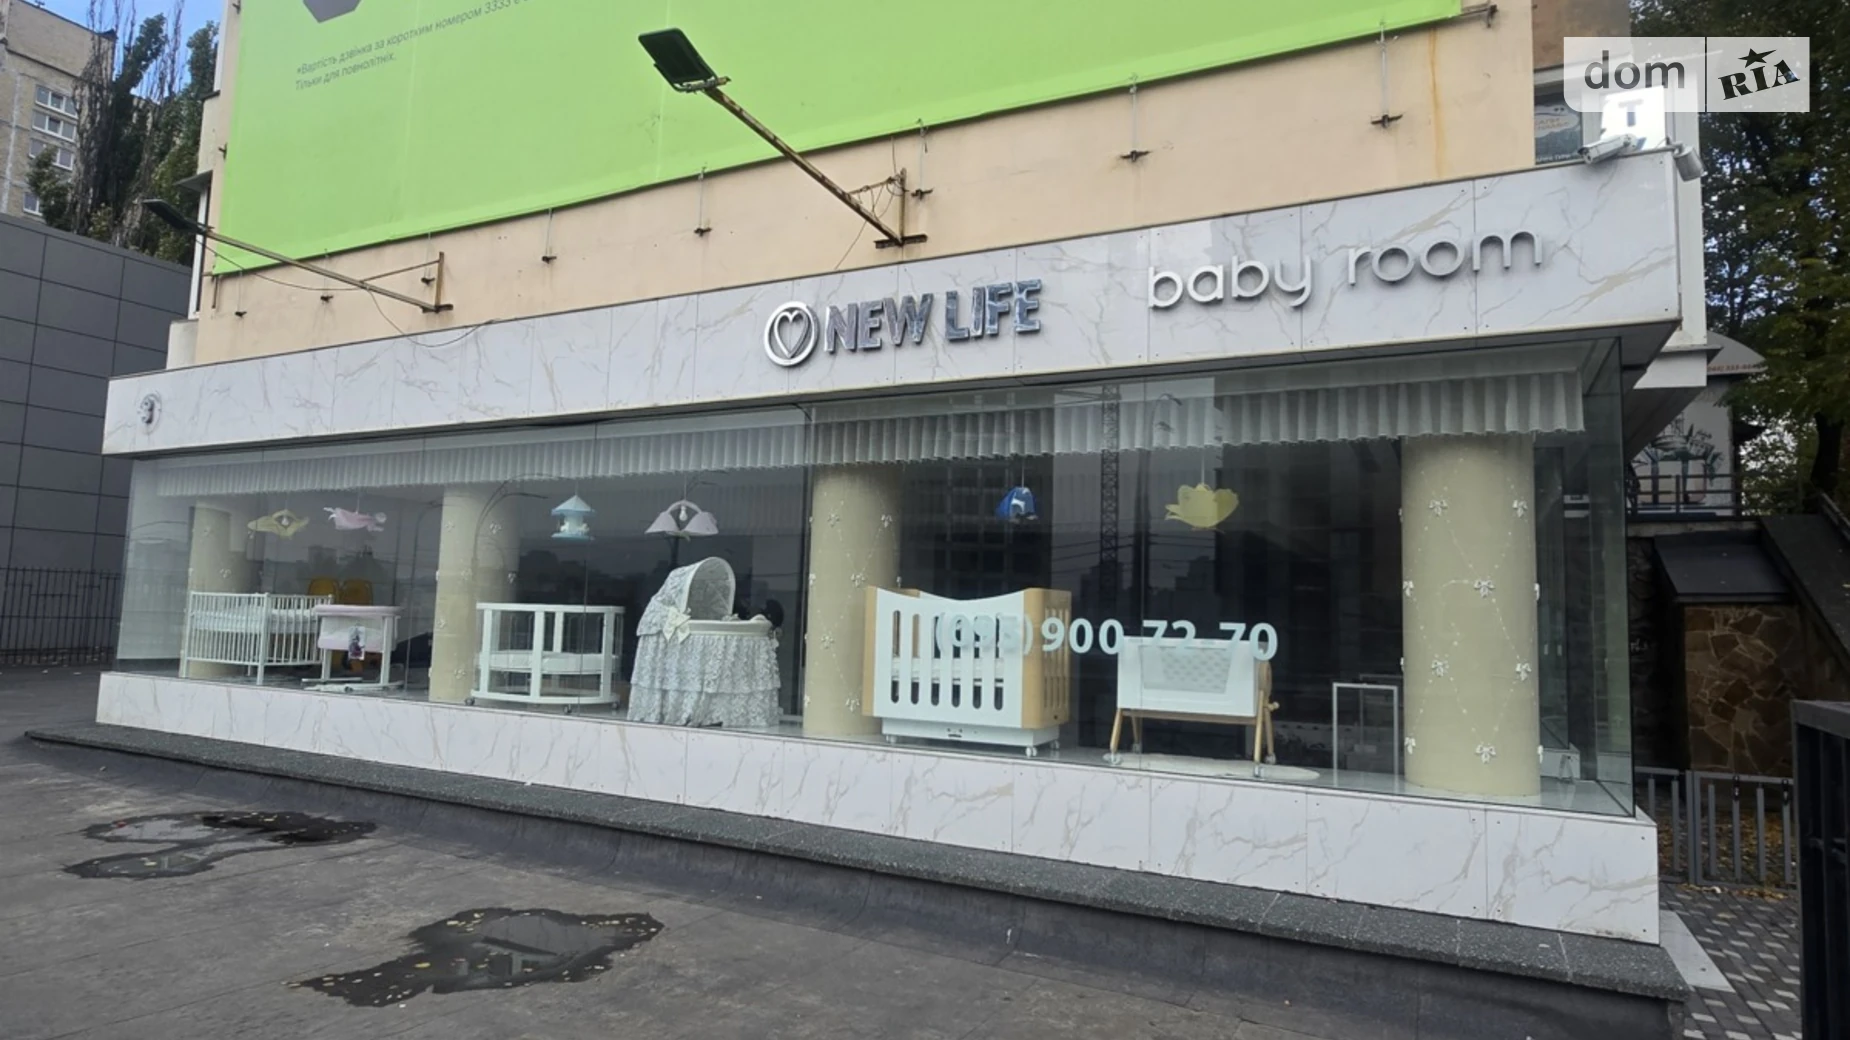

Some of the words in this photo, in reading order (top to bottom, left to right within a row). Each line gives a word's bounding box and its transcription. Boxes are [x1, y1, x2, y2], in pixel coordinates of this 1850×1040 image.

[340, 43, 372, 64] дзвінка
[374, 39, 385, 50] за
[386, 23, 433, 46] коротким
[435, 7, 482, 29] номером
[295, 76, 322, 91] Тільки
[323, 69, 339, 85] для
[1148, 254, 1313, 309] baby
[1348, 230, 1542, 286] room
[825, 292, 934, 354] NEW
[945, 279, 1042, 343] LIFE
